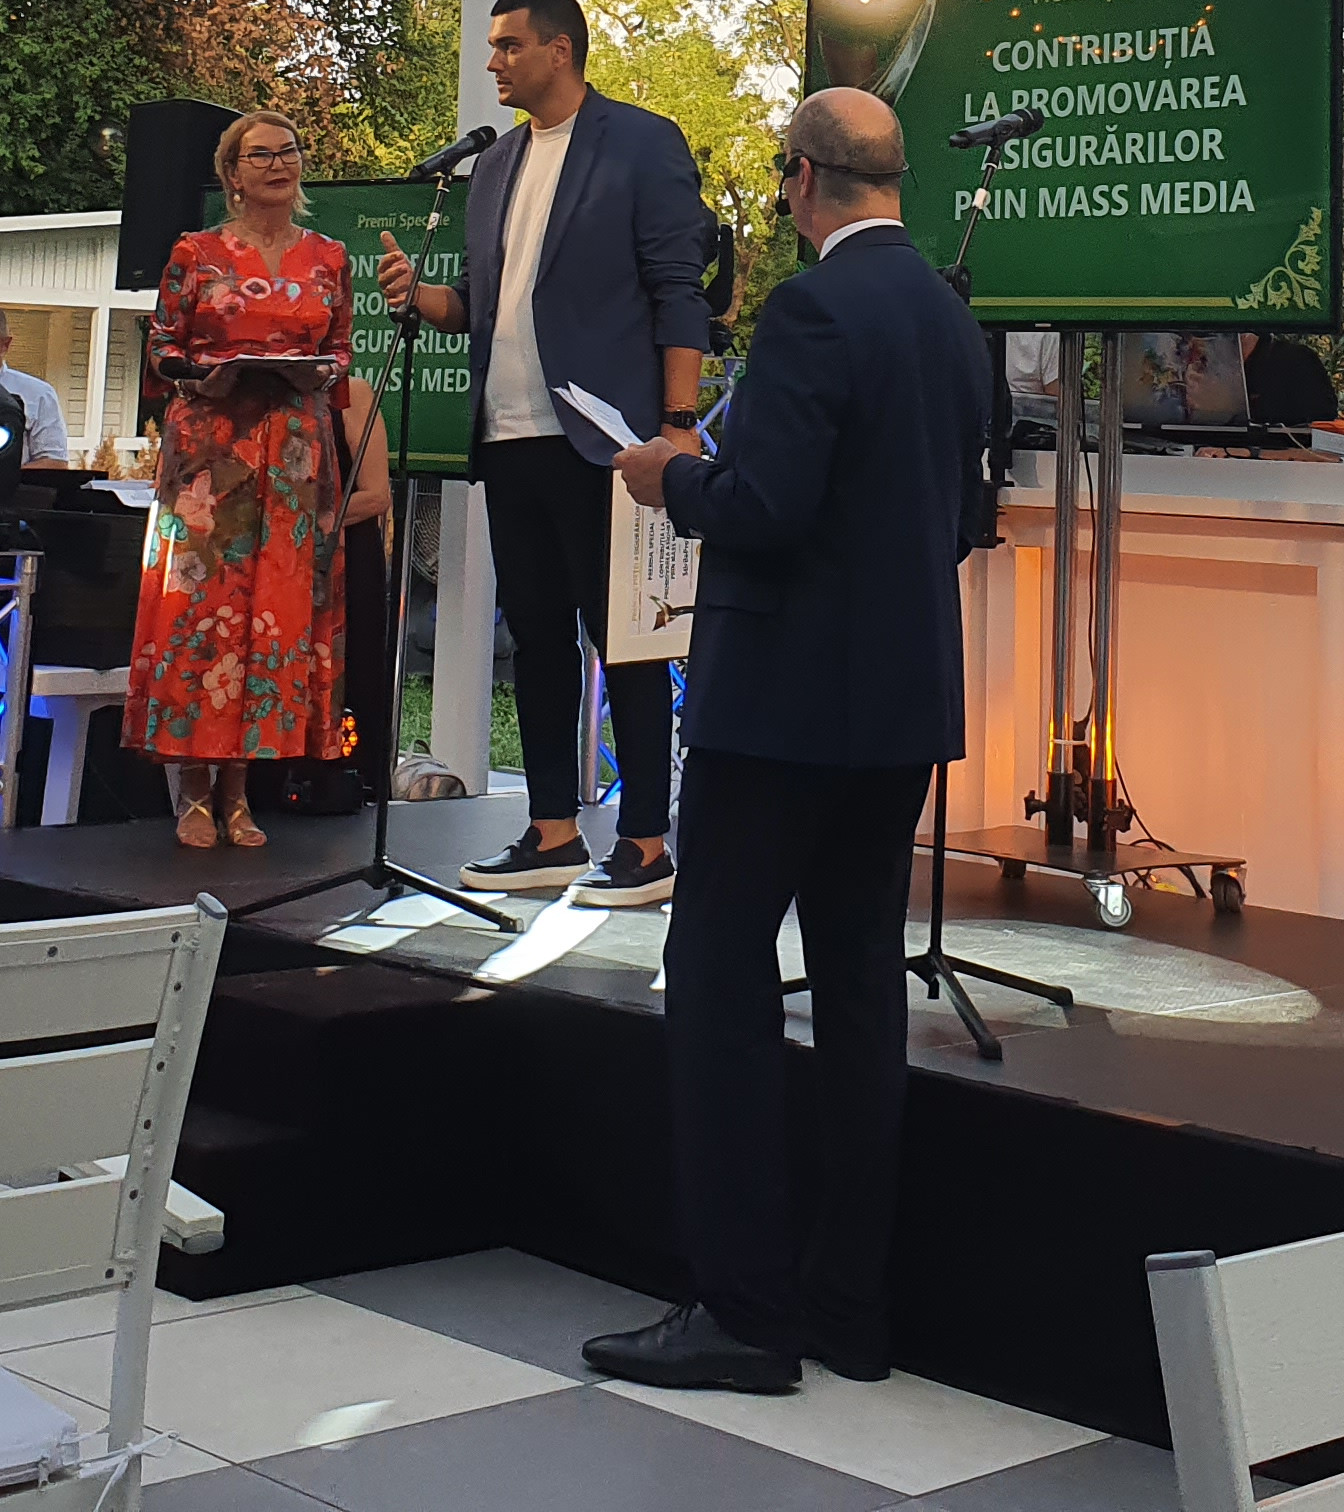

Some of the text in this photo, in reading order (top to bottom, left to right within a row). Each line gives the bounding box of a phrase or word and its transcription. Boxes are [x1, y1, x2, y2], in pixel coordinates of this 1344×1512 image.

[992, 24, 1215, 72] CONTRIBUȚIA
[964, 74, 1247, 123] LA PROMOVAREA
[1038, 184, 1129, 218] MASS
[1140, 179, 1255, 216] MEDIA
[357, 213, 396, 229] Premii
[421, 368, 471, 393] MED
